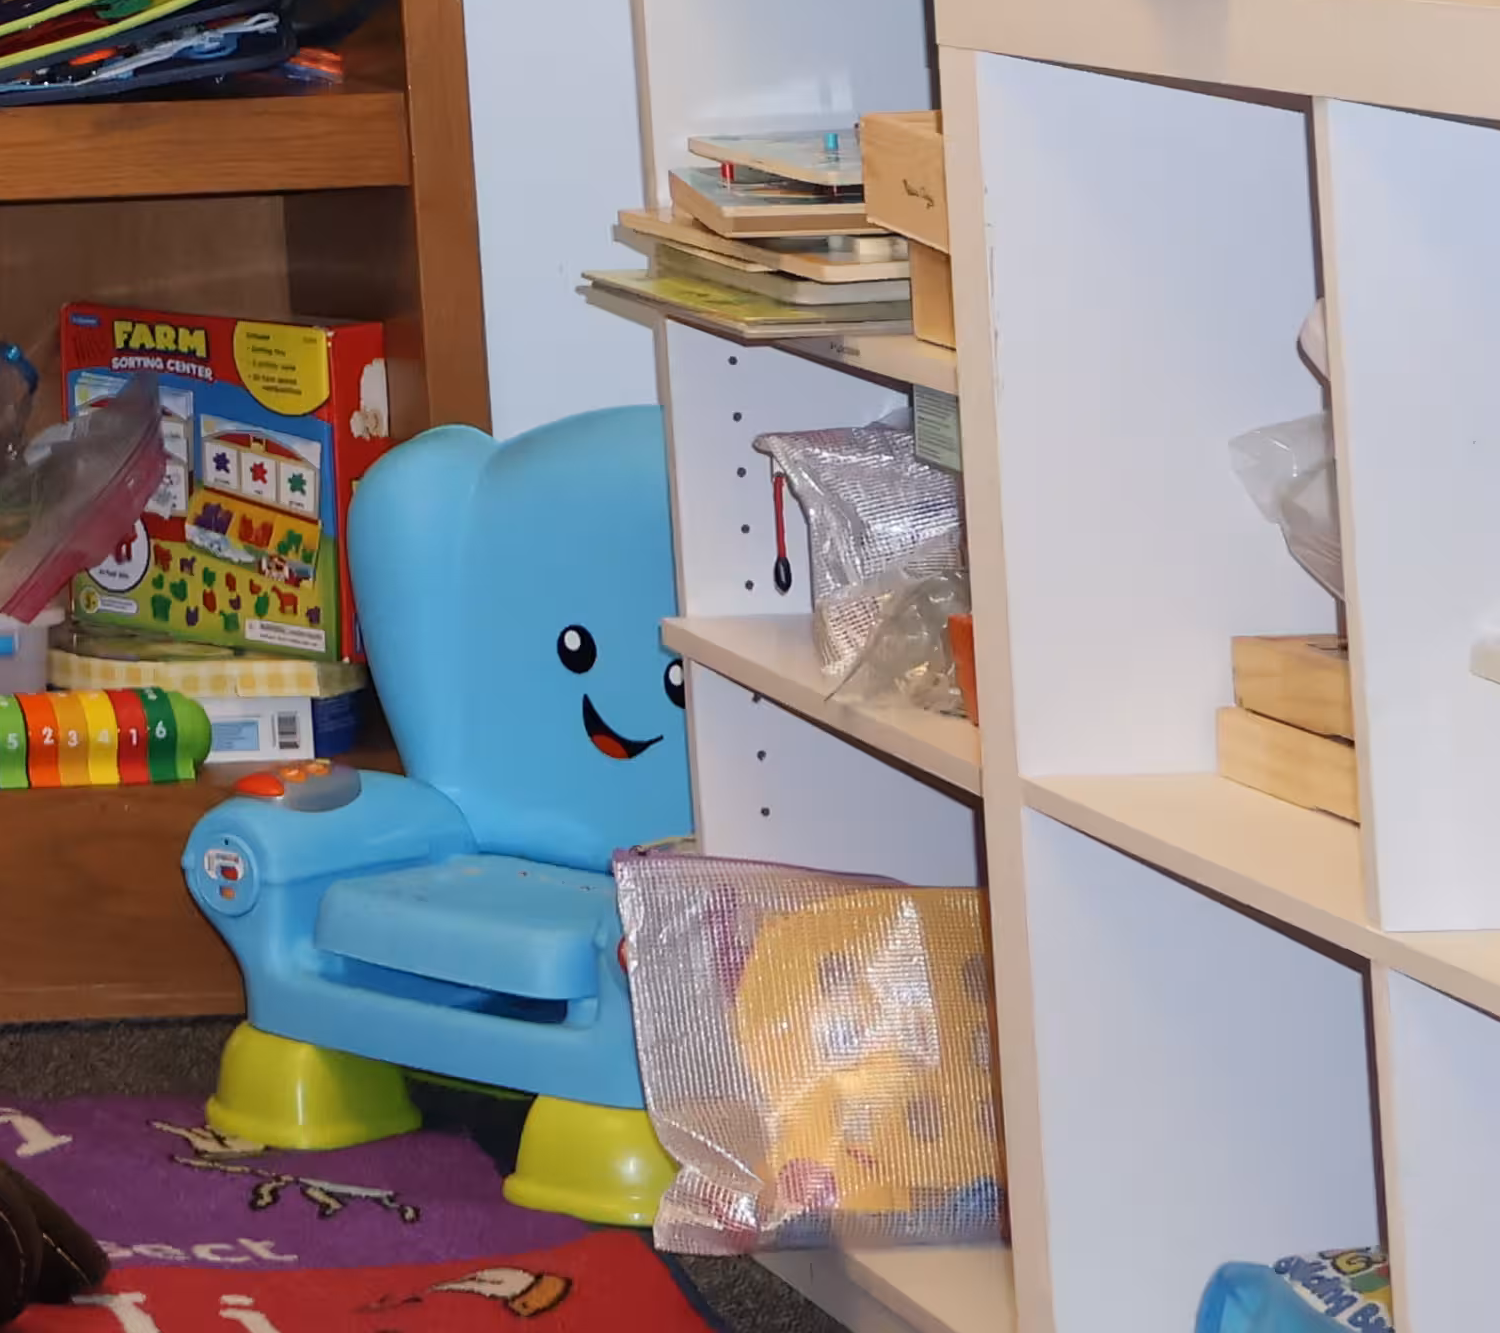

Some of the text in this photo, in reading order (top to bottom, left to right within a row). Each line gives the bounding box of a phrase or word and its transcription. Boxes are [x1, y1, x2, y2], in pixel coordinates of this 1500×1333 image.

[113, 320, 208, 358] FARM
[111, 356, 214, 382] SORTING CENTER
[7, 733, 19, 750] 5
[42, 727, 54, 745] 2
[67, 730, 79, 747] 3
[129, 728, 138, 746] 1
[155, 720, 167, 739] 6
[97, 1237, 299, 1262] sect
